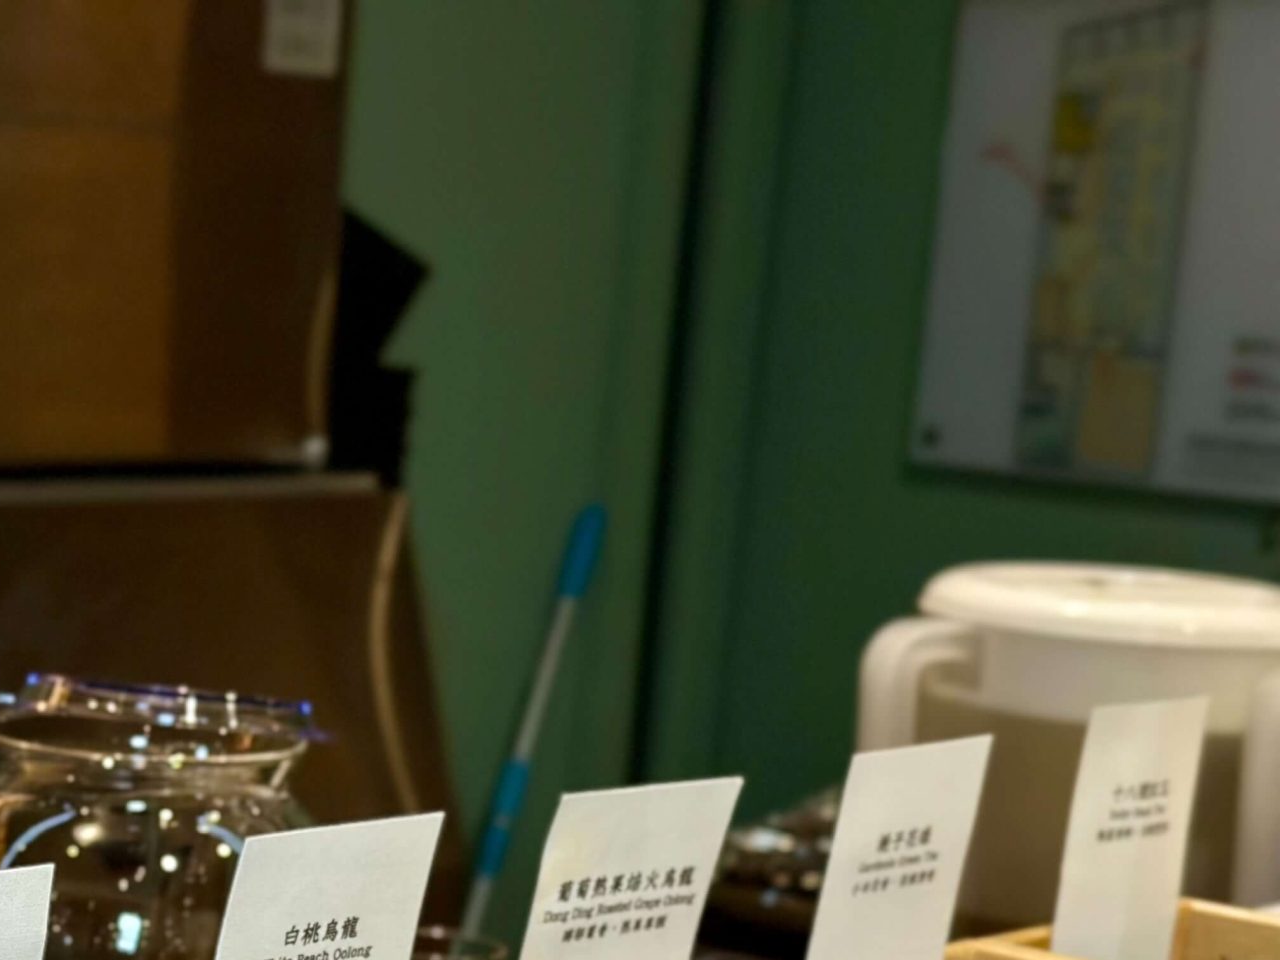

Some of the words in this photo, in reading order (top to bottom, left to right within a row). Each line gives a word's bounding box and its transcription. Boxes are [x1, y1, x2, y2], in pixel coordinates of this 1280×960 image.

[543, 909, 570, 924] Dong
[284, 915, 359, 946] 白桃烏龍
[333, 945, 373, 960] Oolong
